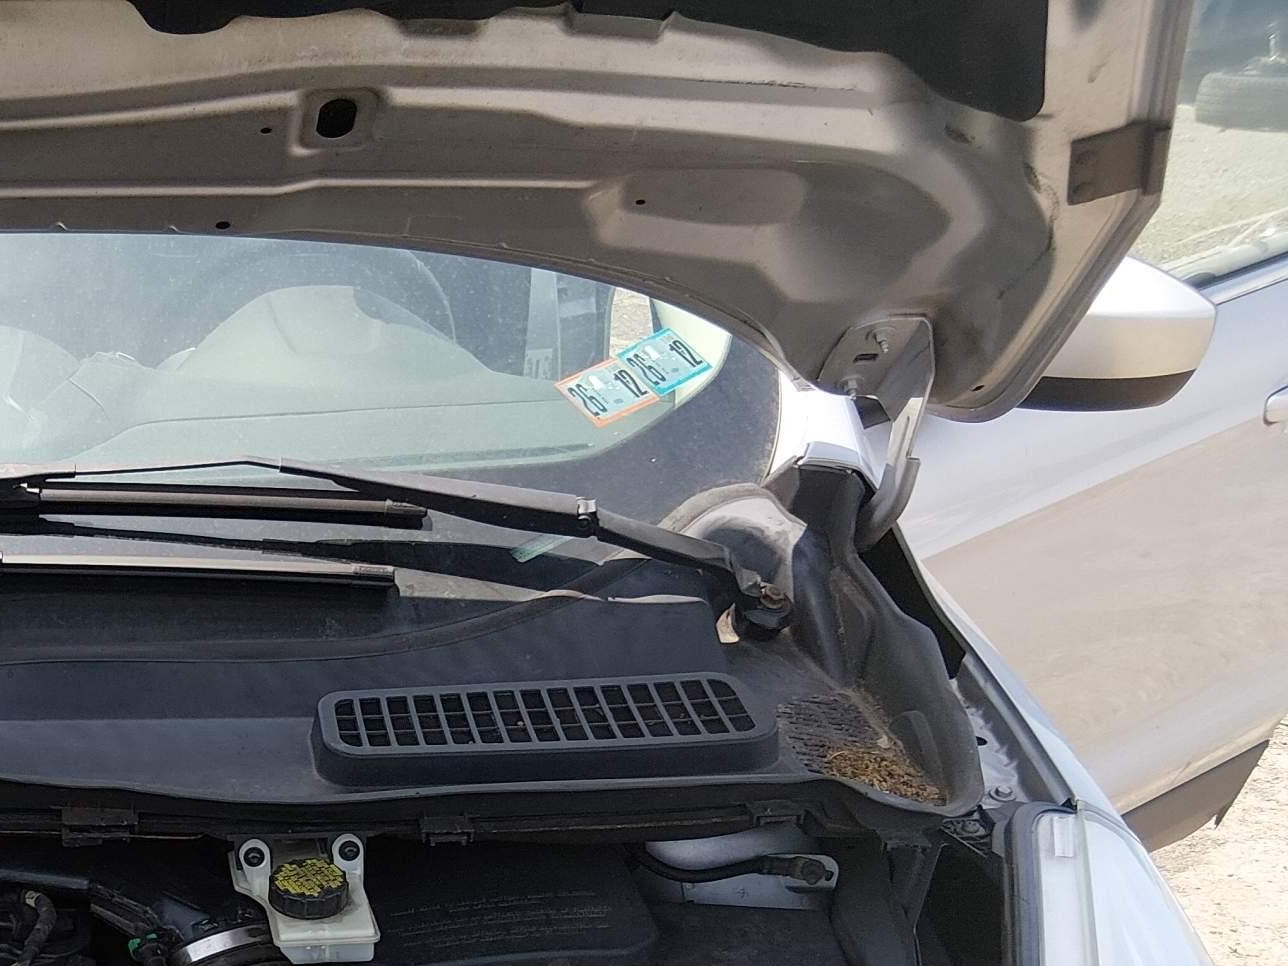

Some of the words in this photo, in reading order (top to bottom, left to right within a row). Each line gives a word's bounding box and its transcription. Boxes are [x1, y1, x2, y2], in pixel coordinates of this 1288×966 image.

[626, 353, 667, 386] 26
[668, 339, 703, 368] 12
[567, 383, 608, 417] 26
[614, 369, 650, 398] 12
